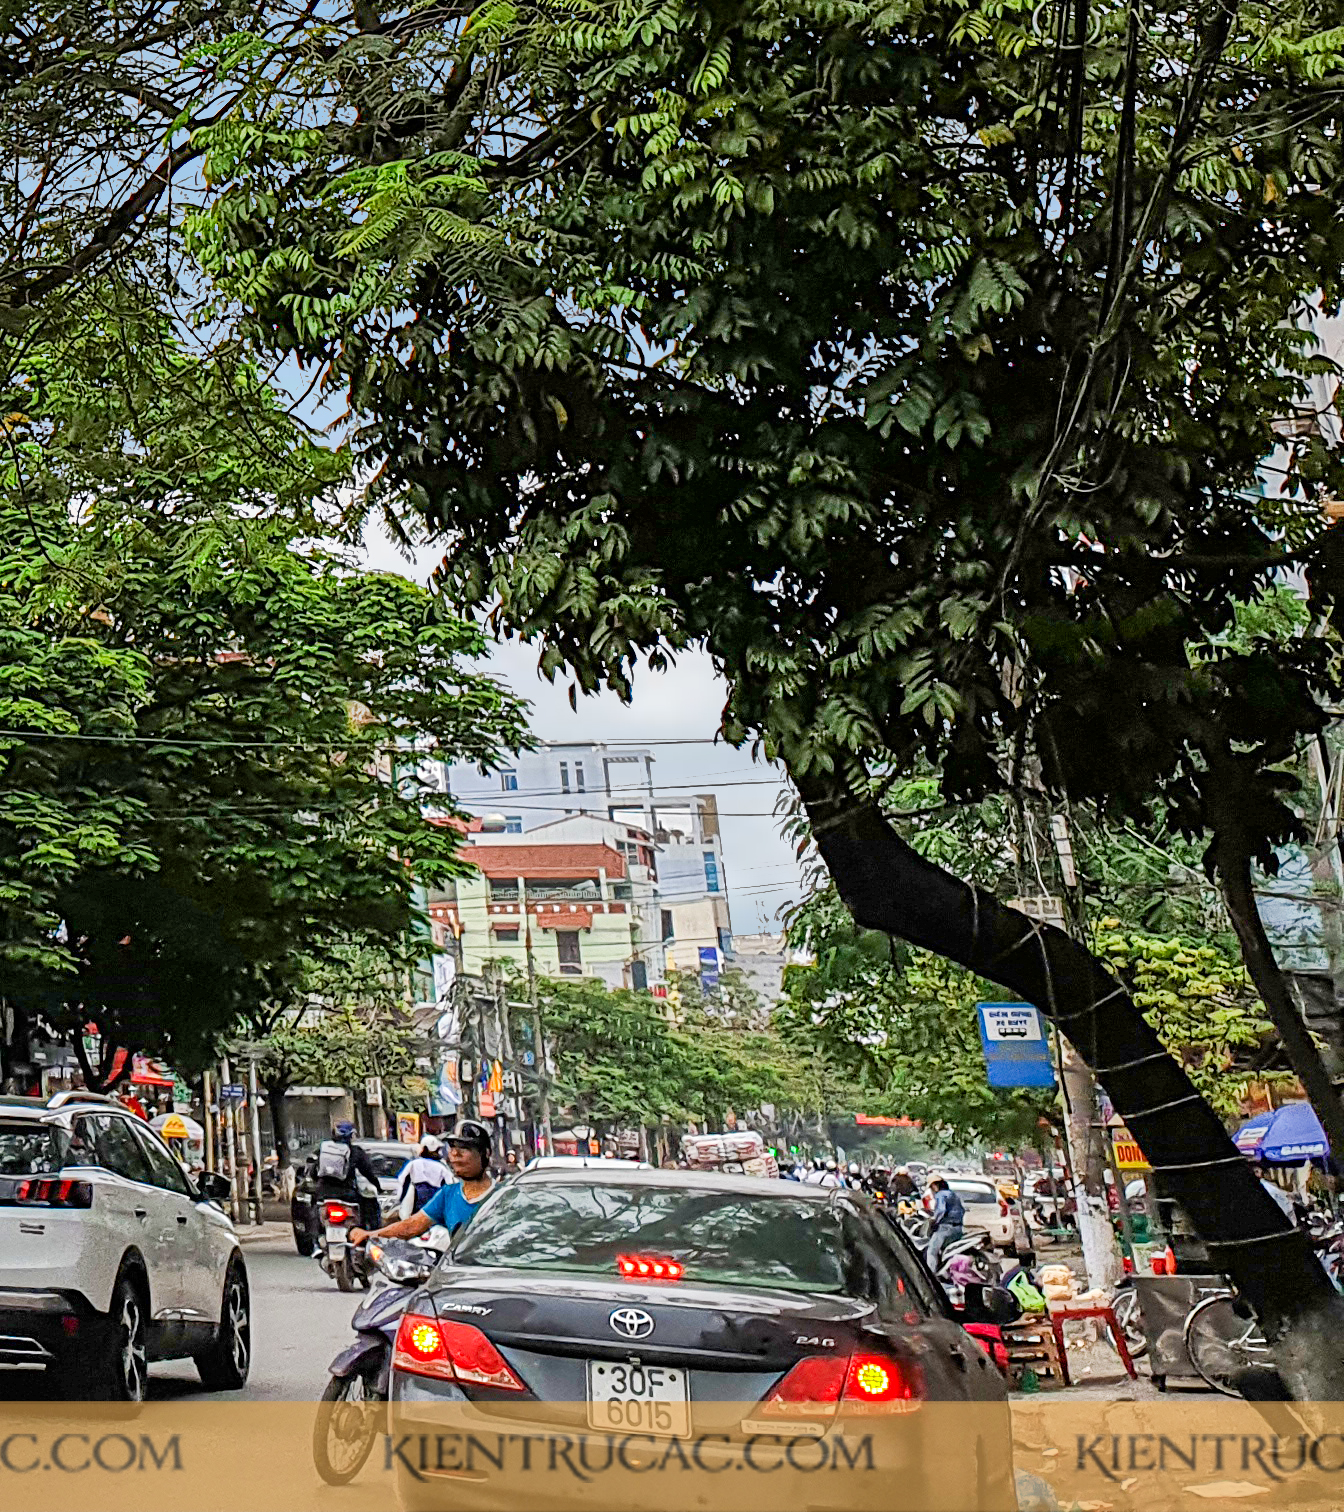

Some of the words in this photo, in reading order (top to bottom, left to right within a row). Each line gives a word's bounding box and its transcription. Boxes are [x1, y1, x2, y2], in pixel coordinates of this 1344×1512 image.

[442, 1302, 493, 1316] CAMRY
[610, 1365, 665, 1399] 30F
[606, 1397, 673, 1432] 6015
